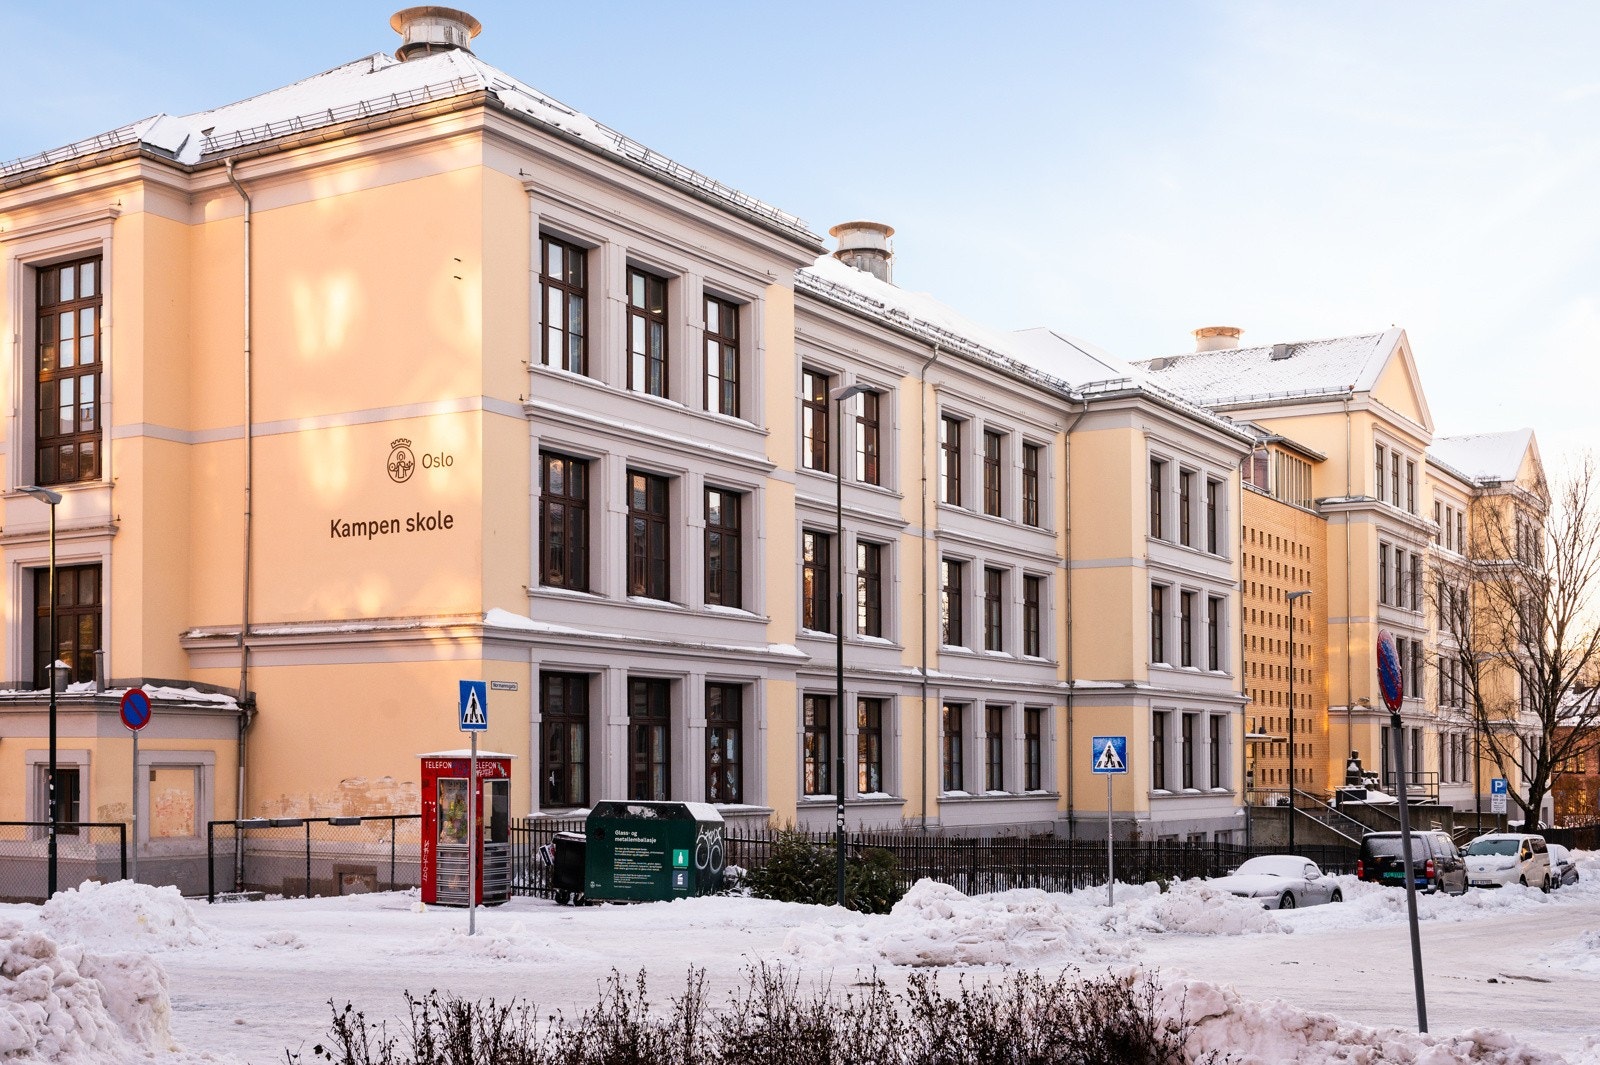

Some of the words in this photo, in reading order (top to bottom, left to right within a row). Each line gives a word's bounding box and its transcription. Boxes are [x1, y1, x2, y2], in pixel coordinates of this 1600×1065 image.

[422, 452, 454, 469] Oslo
[330, 518, 400, 540] Kampen
[406, 510, 454, 532] skole
[425, 761, 453, 769] TELEFON
[476, 761, 497, 769] ELEFON
[1494, 780, 1503, 792] P
